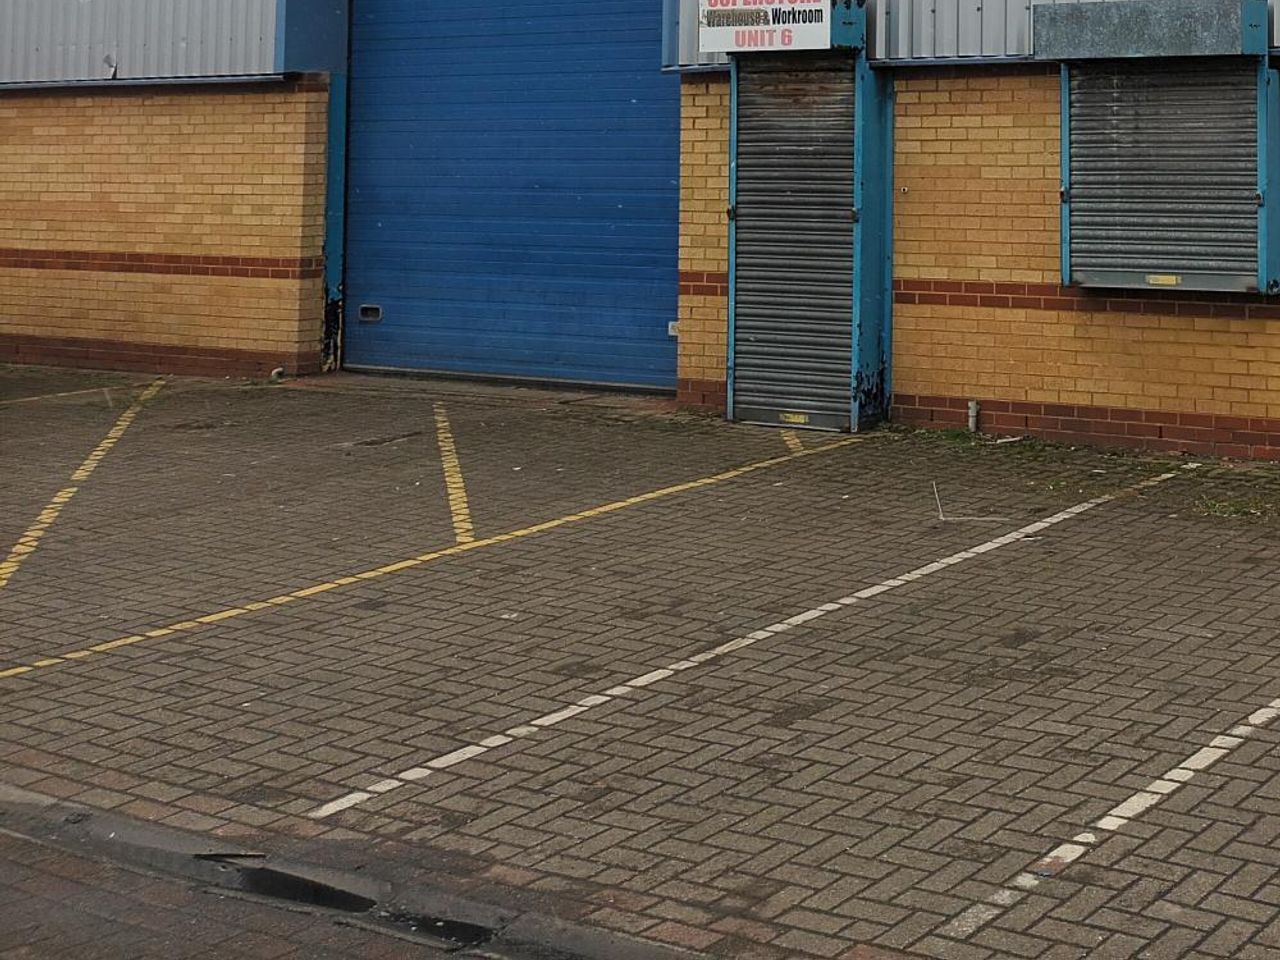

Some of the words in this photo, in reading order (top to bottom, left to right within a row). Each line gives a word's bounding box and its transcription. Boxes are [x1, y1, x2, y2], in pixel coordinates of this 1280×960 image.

[771, 7, 823, 25] Workroom
[735, 29, 776, 47] UNIT
[780, 28, 793, 46] 6
